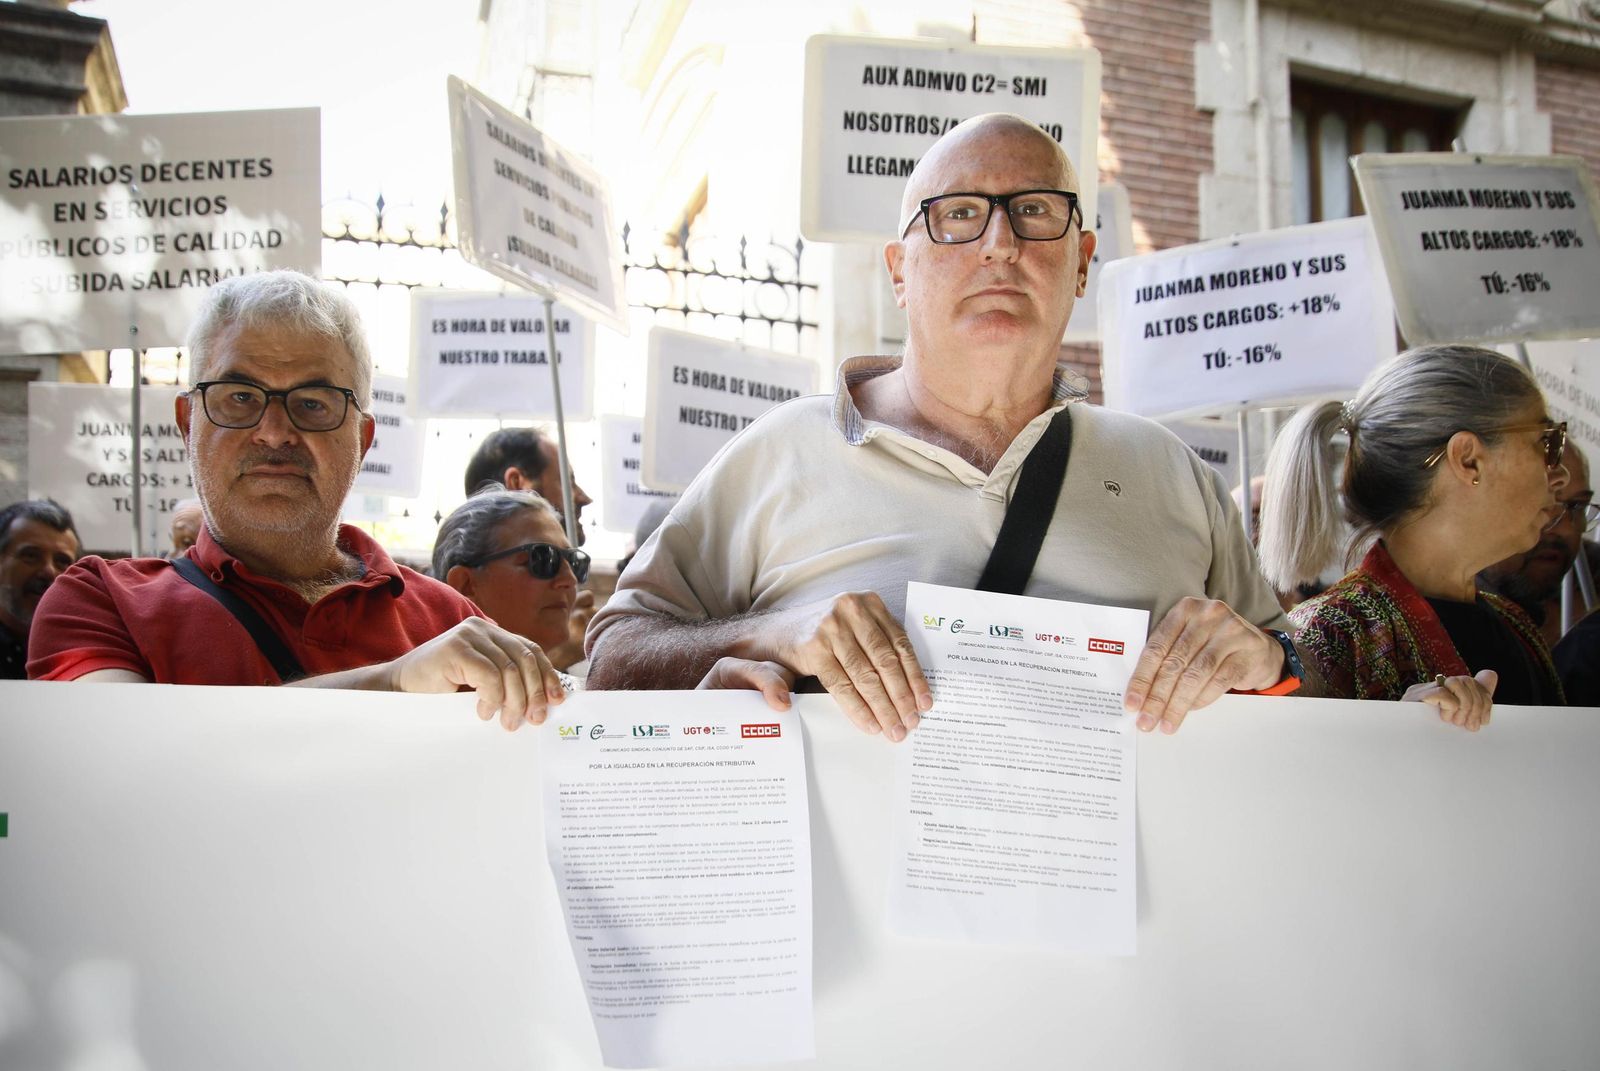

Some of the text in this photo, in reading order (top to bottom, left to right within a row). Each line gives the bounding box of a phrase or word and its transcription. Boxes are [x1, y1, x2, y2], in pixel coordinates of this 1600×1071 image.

[861, 65, 898, 86] AUX
[903, 67, 966, 92] ADMVO
[1012, 75, 1047, 97] SMI
[486, 119, 536, 163] SALARIOS
[8, 157, 273, 189] SALARIOS DECENTES
[847, 154, 921, 177] LLEGAM
[54, 195, 228, 222] EN SERVICIOS
[1401, 188, 1576, 210] JUANMA MORENO Y SUS
[0, 228, 282, 260] PÚBLICOS DE CALIDAD
[1421, 228, 1584, 251] ALTOS CARGOS: +18%
[1135, 253, 1346, 305] JUANMA MORENO Y SUS
[1481, 270, 1551, 295] TÚ: -16%
[432, 318, 571, 334] ES HORA DE VALOAR
[1144, 293, 1341, 339] ALTOS CARGOS: +18%
[439, 349, 500, 365] NUESTRO
[1203, 342, 1282, 371] TÚ: -16%
[673, 365, 688, 386] ES
[692, 368, 726, 392] HORA
[730, 376, 744, 396] DE
[679, 404, 737, 432] NUESTRO
[103, 448, 186, 462] Y SS ALT
[1035, 633, 1053, 642] UGT
[970, 656, 1000, 665] IGUALDAD
[1061, 668, 1098, 678] RETRIBUTIVA
[683, 726, 702, 735] UGT
